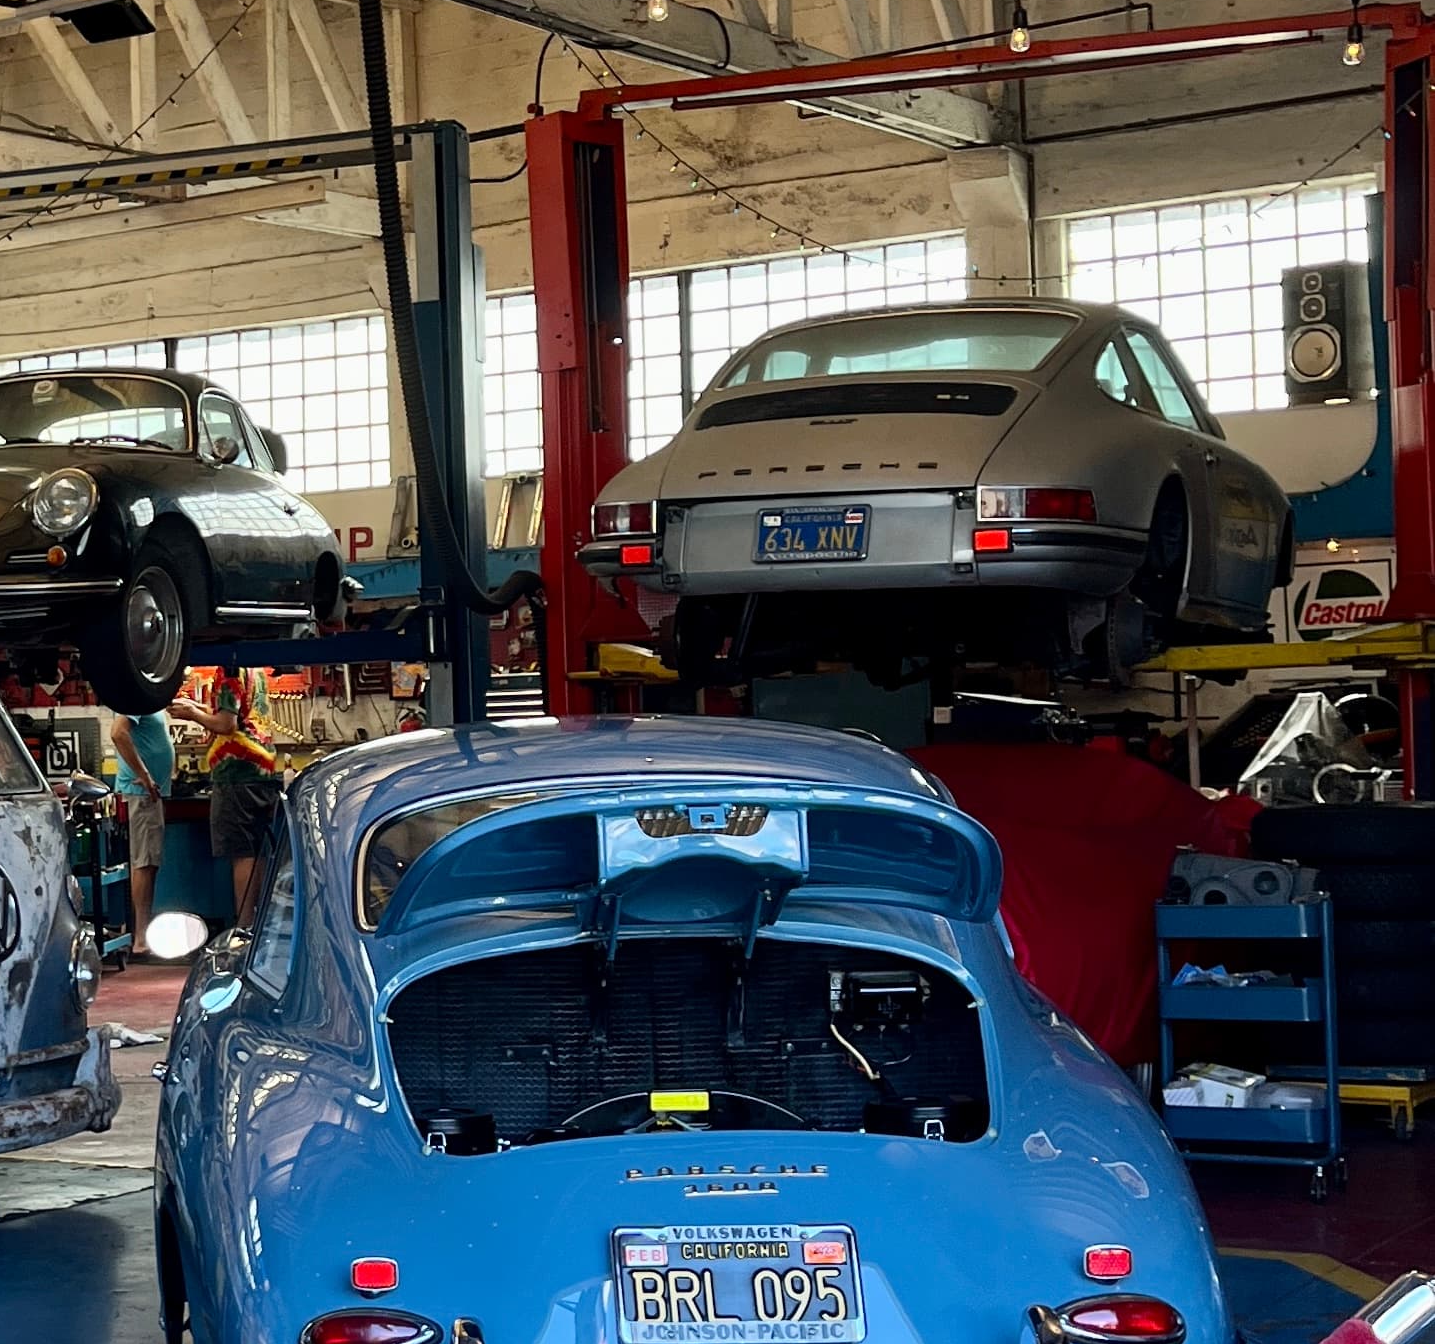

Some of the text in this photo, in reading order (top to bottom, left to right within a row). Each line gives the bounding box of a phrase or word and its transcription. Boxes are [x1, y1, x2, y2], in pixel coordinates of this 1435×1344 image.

[764, 526, 859, 552] 634 XNV
[626, 1163, 829, 1180] PORSCHE
[672, 1226, 793, 1241] VOLKSWAGEN
[627, 1249, 662, 1263] FEB
[681, 1242, 791, 1260] CALIFORNIA
[631, 1267, 848, 1323] BRL 095
[641, 1322, 846, 1342] JOHNSON-PACIFIC
